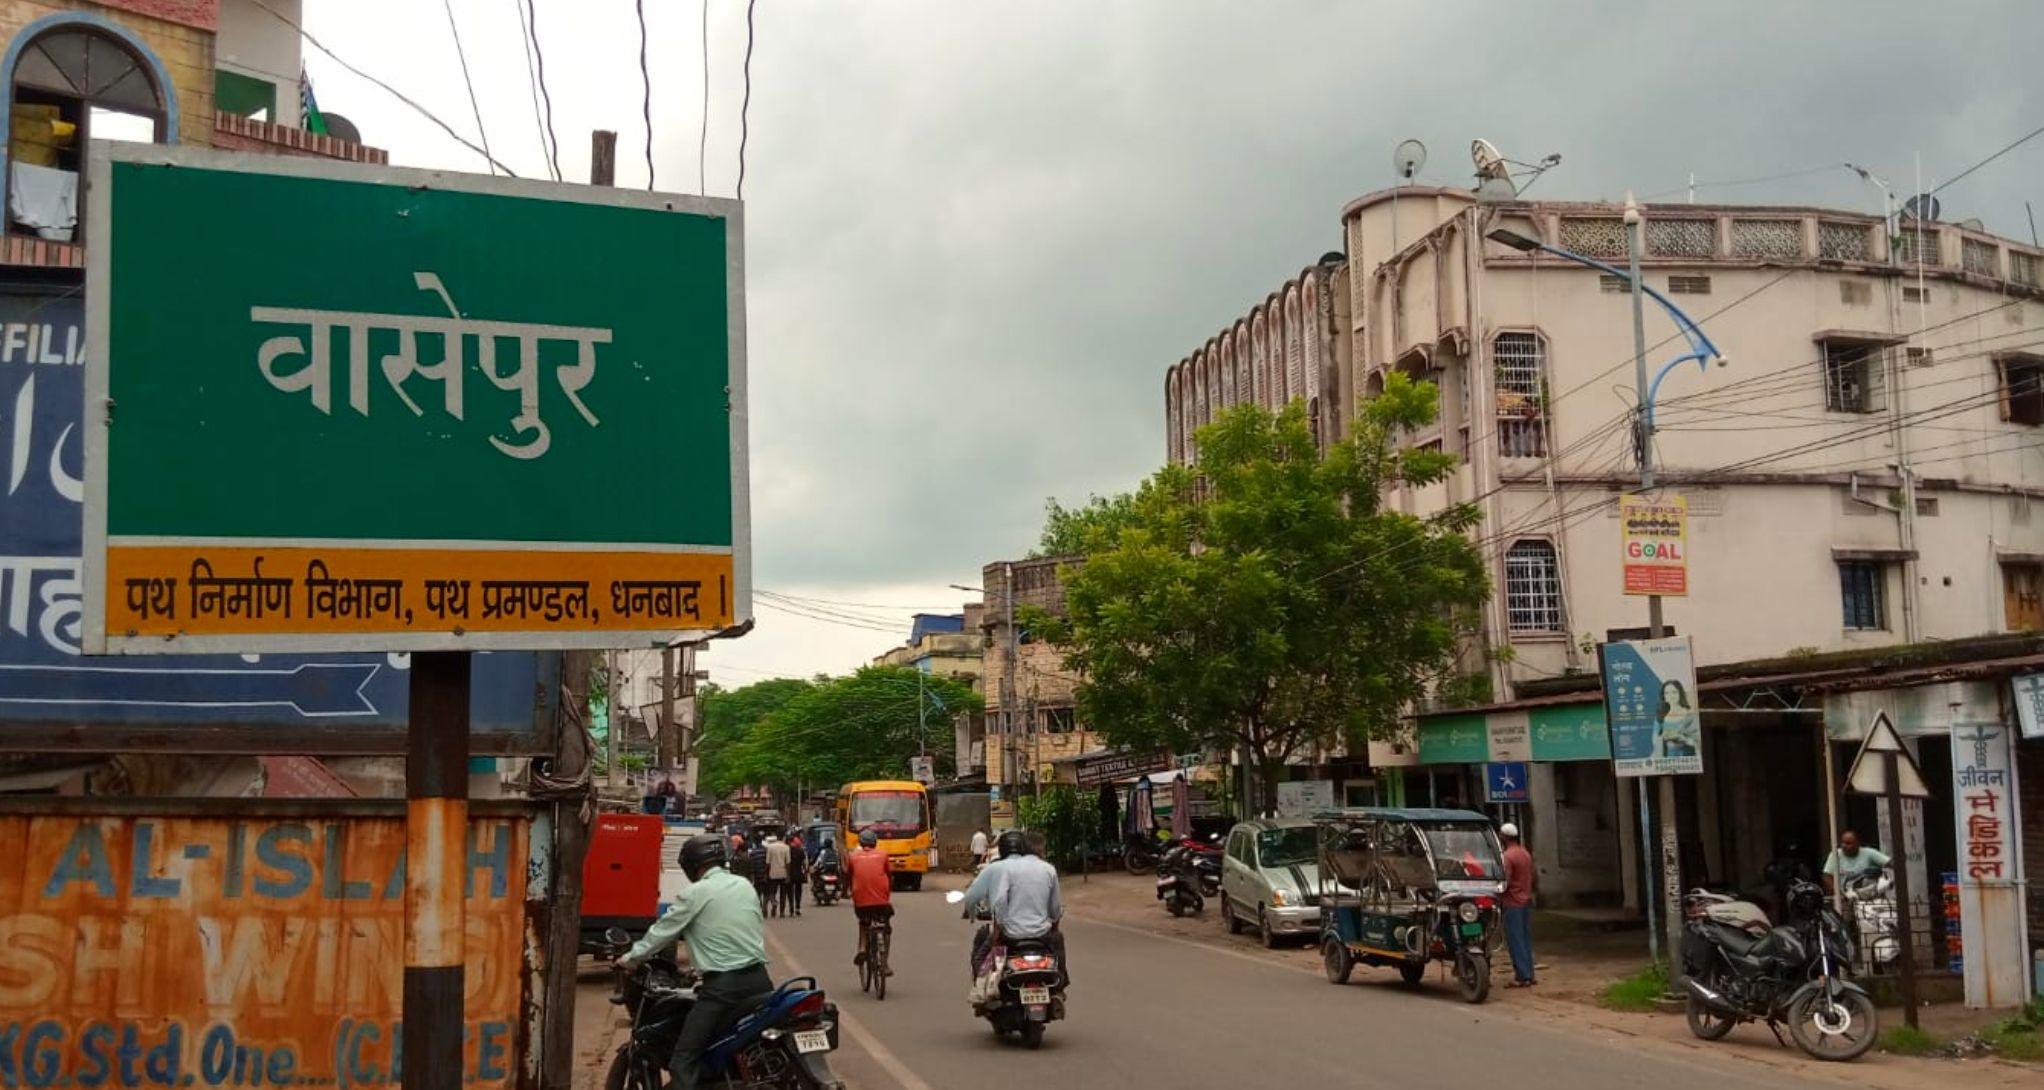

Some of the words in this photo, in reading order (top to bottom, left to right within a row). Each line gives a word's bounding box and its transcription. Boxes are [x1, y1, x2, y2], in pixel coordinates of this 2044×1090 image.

[251, 271, 612, 459] वासेपुर
[1628, 542, 1681, 560] GOAL
[125, 578, 177, 620] पथ
[189, 558, 293, 619] निर्माण
[305, 559, 413, 625] विभाग,
[425, 580, 470, 619] पथ
[482, 580, 599, 625] प्रमण्डल,
[611, 580, 701, 620] धनबाद
[1957, 765, 2005, 787] जीवन
